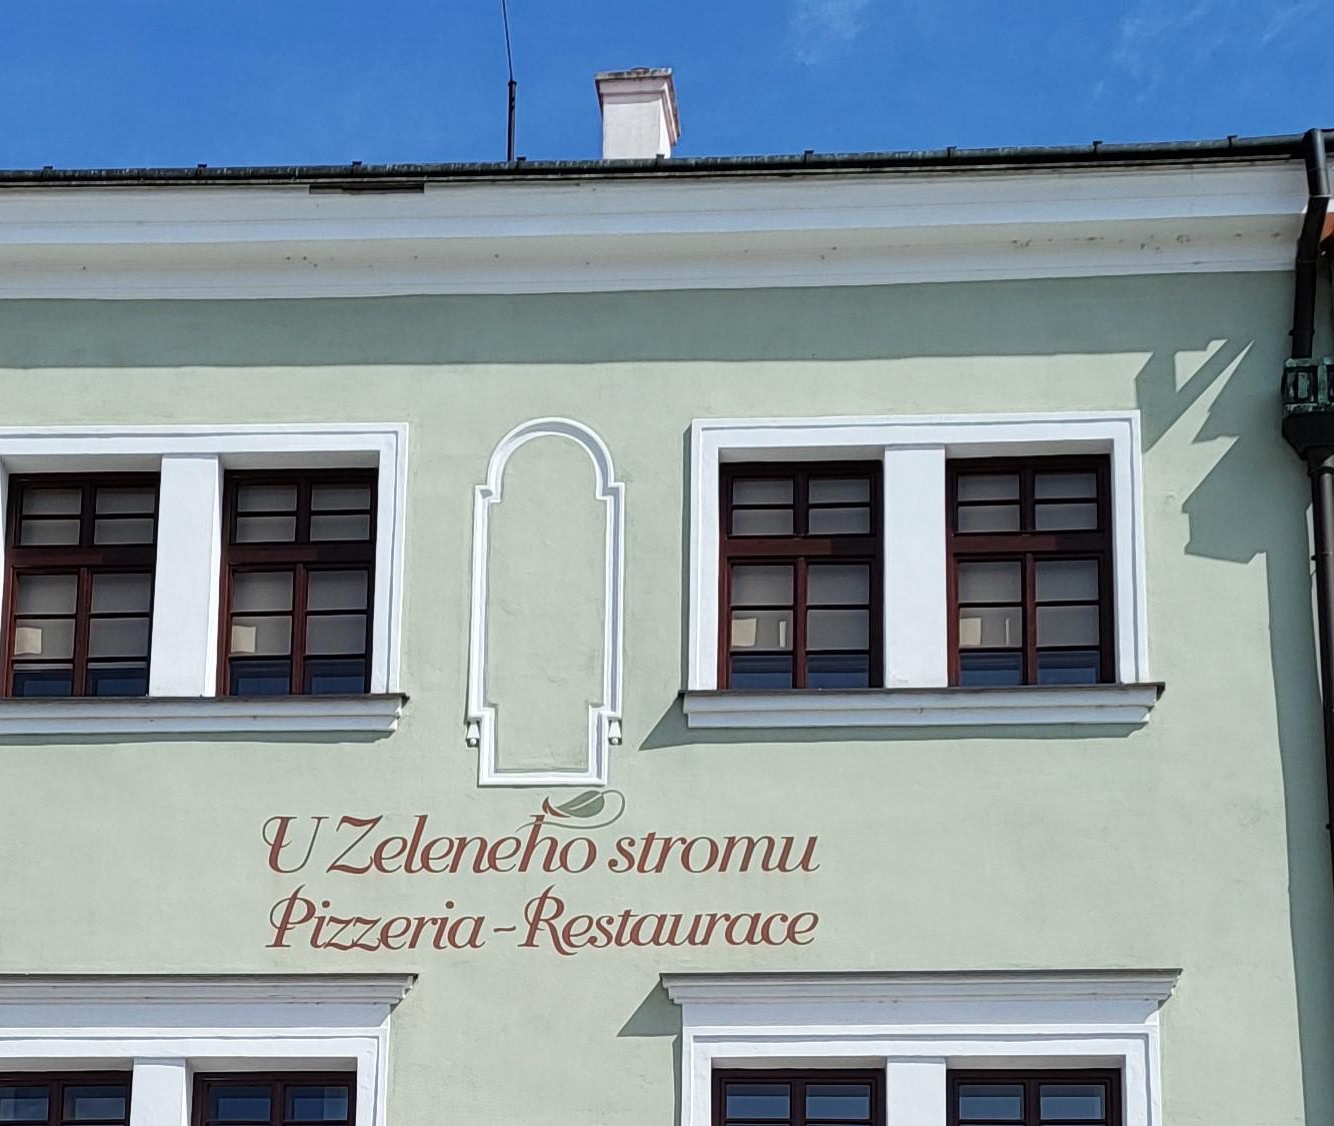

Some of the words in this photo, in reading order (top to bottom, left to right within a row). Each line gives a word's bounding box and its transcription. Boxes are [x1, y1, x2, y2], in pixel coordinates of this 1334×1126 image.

[262, 815, 330, 875] U
[608, 831, 821, 875] stromu
[265, 884, 487, 952] Pizzeria
[517, 884, 819, 957] Restaurace
